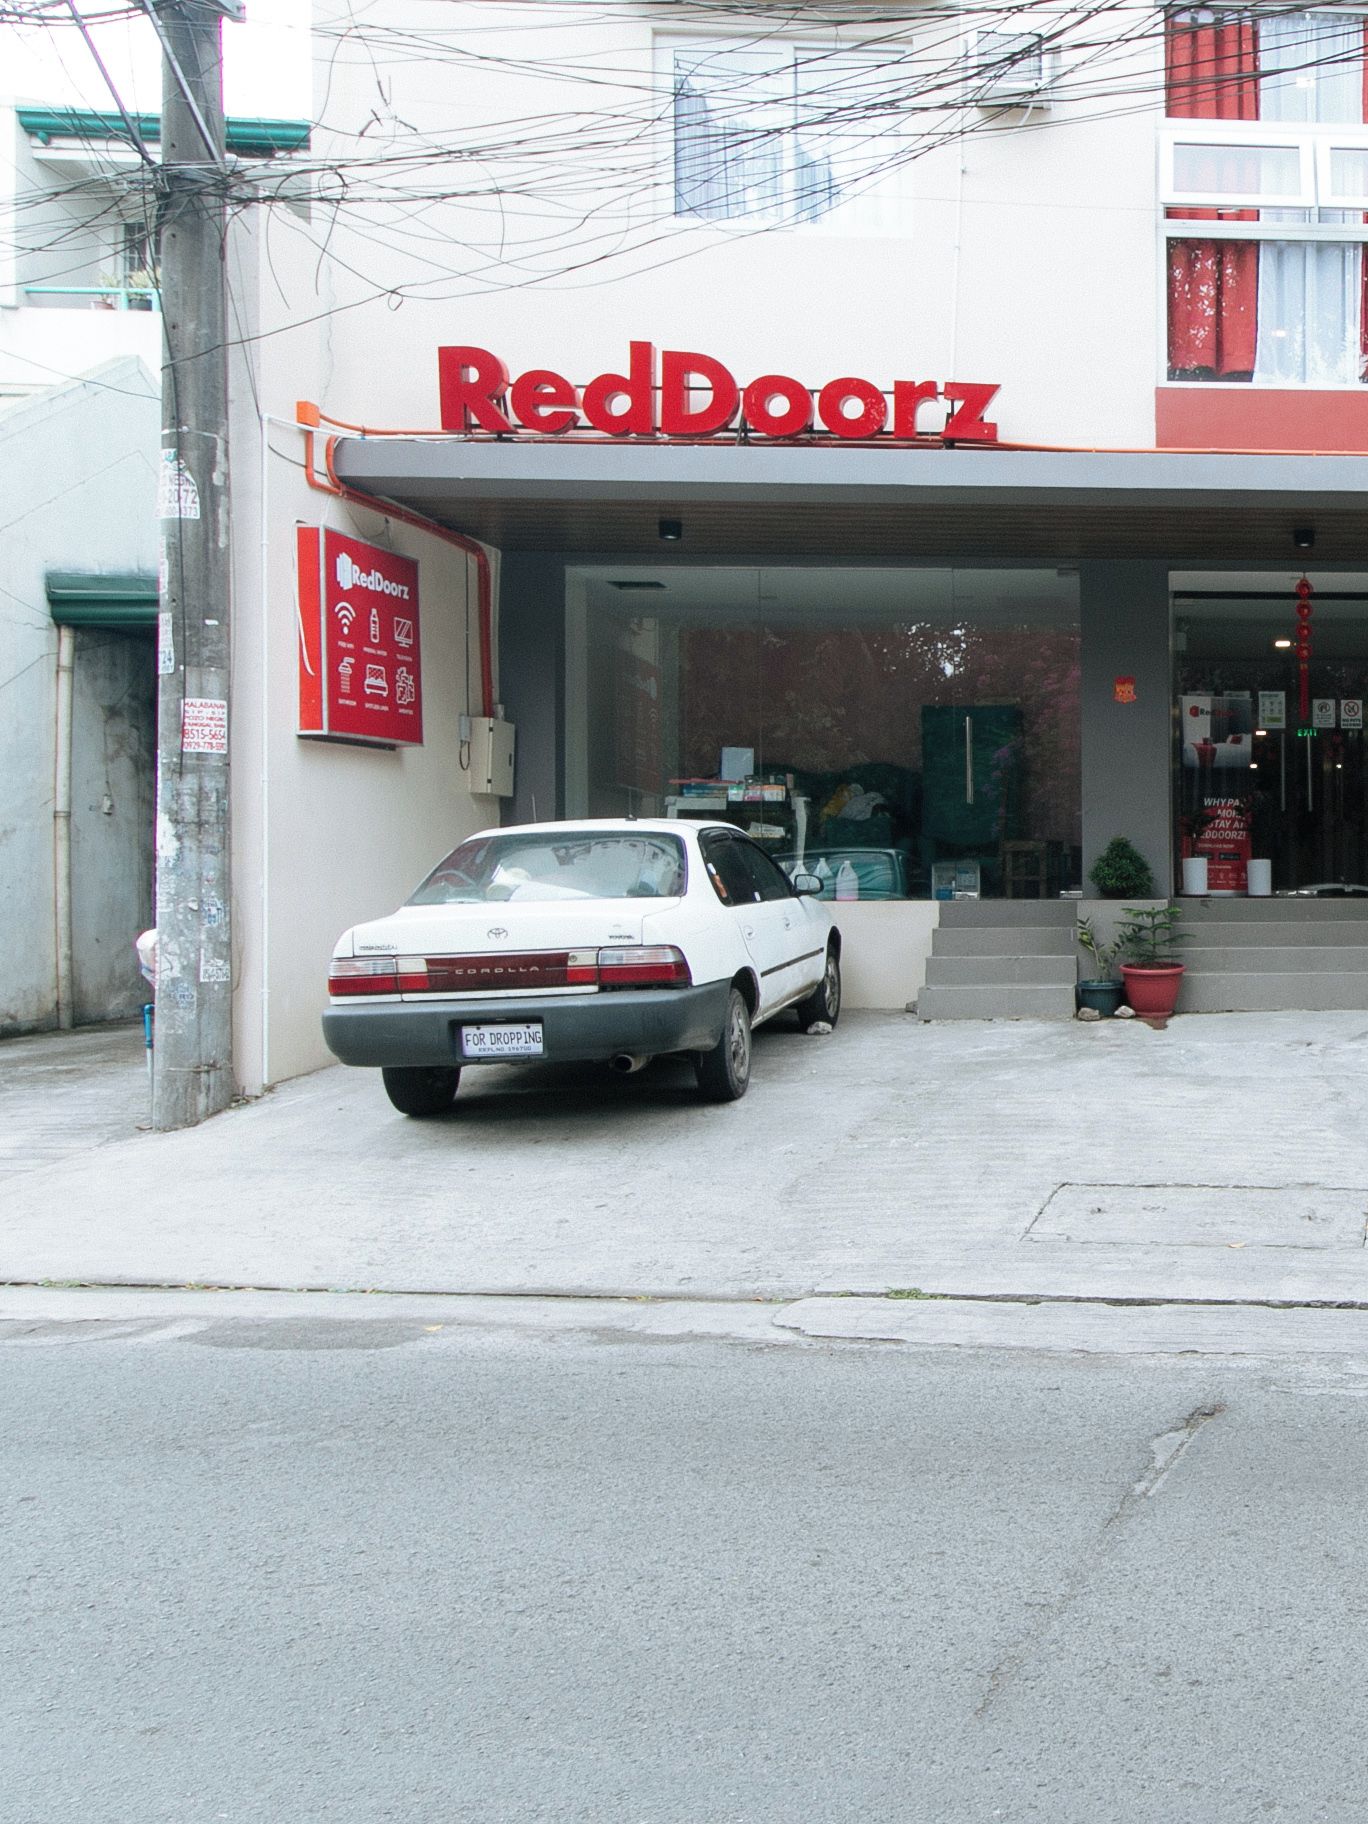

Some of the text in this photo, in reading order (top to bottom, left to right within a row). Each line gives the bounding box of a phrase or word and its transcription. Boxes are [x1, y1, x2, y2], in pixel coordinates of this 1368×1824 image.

[437, 340, 1003, 444] RedDoorz
[351, 564, 410, 600] RedDoorz
[1297, 728, 1318, 737] EXIT
[1203, 797, 1227, 807] WHY
[1193, 830, 1247, 840] DDOORZ!
[455, 966, 540, 975] COROLLA
[465, 1031, 543, 1046] FOR DROPPING
